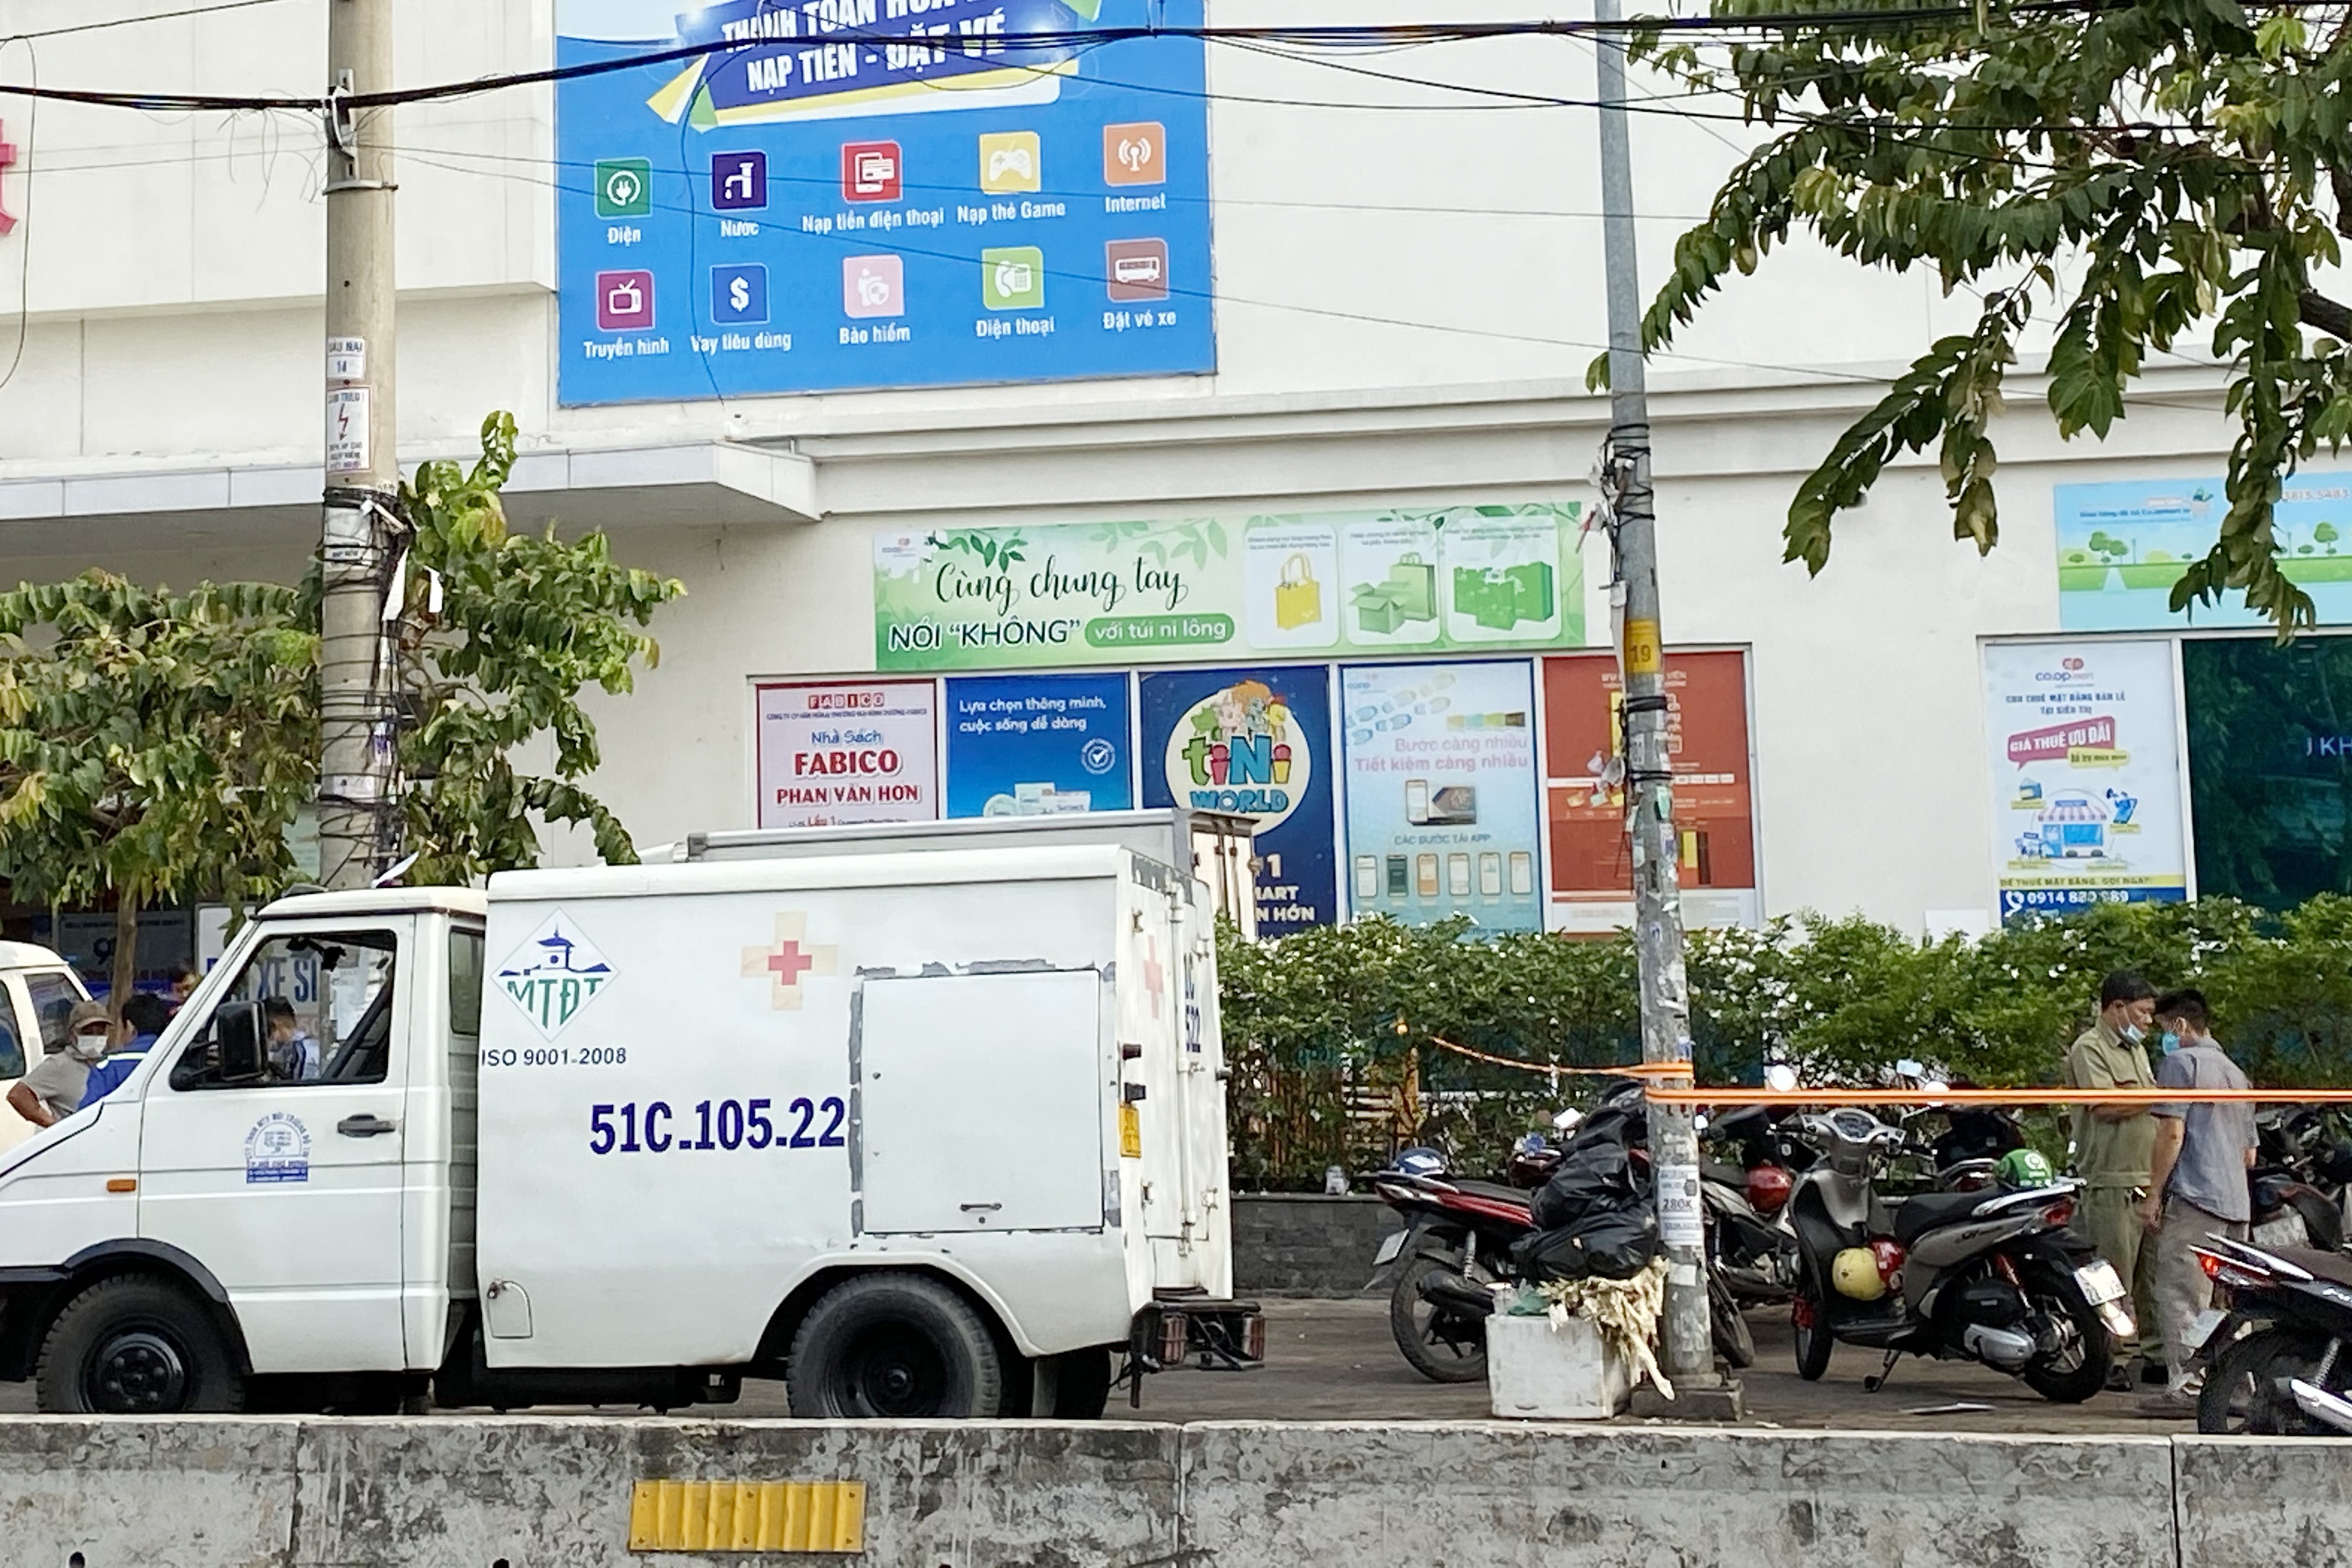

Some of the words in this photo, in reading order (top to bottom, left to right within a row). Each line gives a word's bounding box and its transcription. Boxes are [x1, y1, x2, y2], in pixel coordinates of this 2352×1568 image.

[747, 55, 793, 95] NẠP
[957, 204, 988, 226] Nạp
[1021, 201, 1066, 220] Game
[1105, 194, 1166, 213] Internet
[720, 220, 759, 238] Nước
[801, 214, 833, 237] Nạp
[869, 210, 902, 231] điện
[906, 207, 945, 229] thoại
[608, 227, 641, 247] Điện
[976, 319, 1012, 338] Điện
[1016, 316, 1055, 338] thoại
[1103, 312, 1132, 332] Đặt
[1158, 313, 1176, 327] xe
[583, 336, 634, 361] Truyền
[636, 336, 669, 355] hình
[691, 335, 716, 355] Vay
[754, 332, 792, 352] dùng
[936, 561, 1020, 616] Cùng
[1029, 554, 1127, 612] chung
[1132, 556, 1189, 611] tay
[890, 617, 942, 649] NÓI
[1095, 624, 1124, 641] với
[1128, 623, 1154, 640] túi
[1182, 619, 1227, 642] lông
[1630, 644, 1652, 663] 19
[959, 699, 987, 715] Lựa
[989, 698, 1023, 714] chọn
[1025, 697, 1067, 713] thông
[1069, 695, 1106, 710] minh,
[811, 728, 840, 745] Nhà
[844, 728, 882, 745] Sách
[959, 717, 992, 735] cuộc
[995, 717, 1028, 734] sống
[1051, 717, 1087, 732] dàng
[1395, 737, 1438, 752] Bước
[1442, 736, 1481, 754] càng
[1484, 733, 1528, 749] nhiều
[2010, 736, 2033, 752] GIÁ
[2033, 731, 2067, 751] THUÊ
[2068, 727, 2087, 746] ƯU
[794, 749, 900, 776] FABICO
[1355, 755, 1386, 772] Tiết
[1436, 754, 1476, 771] càng
[1481, 752, 1528, 768] nhiều
[776, 787, 828, 804] PHAN
[1189, 789, 1289, 813] WORLD
[2026, 890, 2065, 905] 0914
[481, 1049, 517, 1066] ISO
[523, 1047, 627, 1066] 9001-2008
[589, 1096, 846, 1154] 51C.105.22
